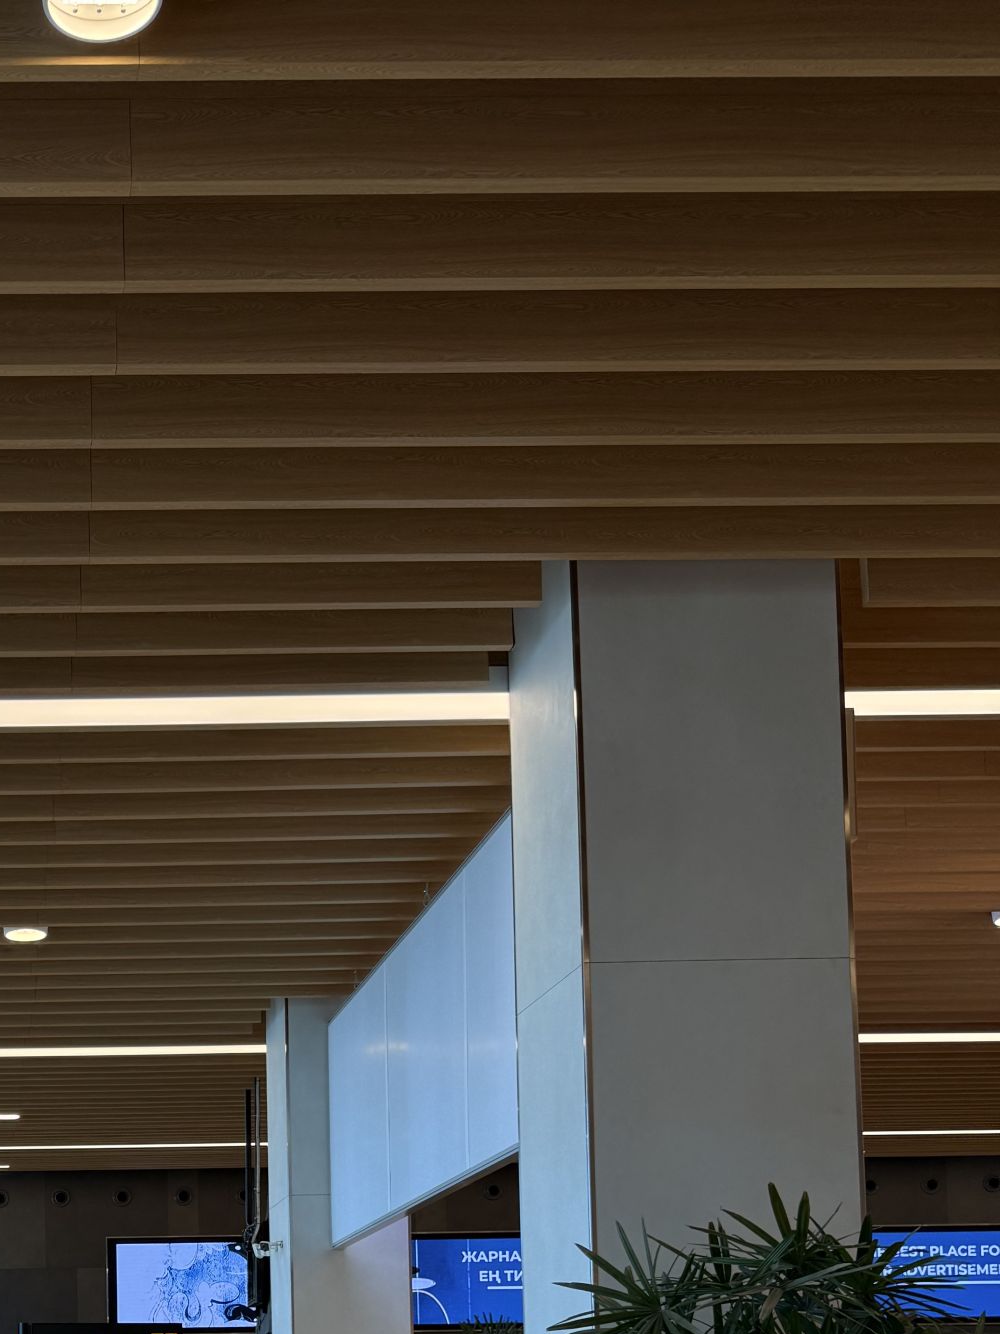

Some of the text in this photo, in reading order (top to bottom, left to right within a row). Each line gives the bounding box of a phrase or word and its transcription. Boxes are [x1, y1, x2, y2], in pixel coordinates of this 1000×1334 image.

[461, 1250, 522, 1263] ЖАРНА
[929, 1245, 976, 1257] PLACE
[479, 1270, 501, 1284] ЕҢ
